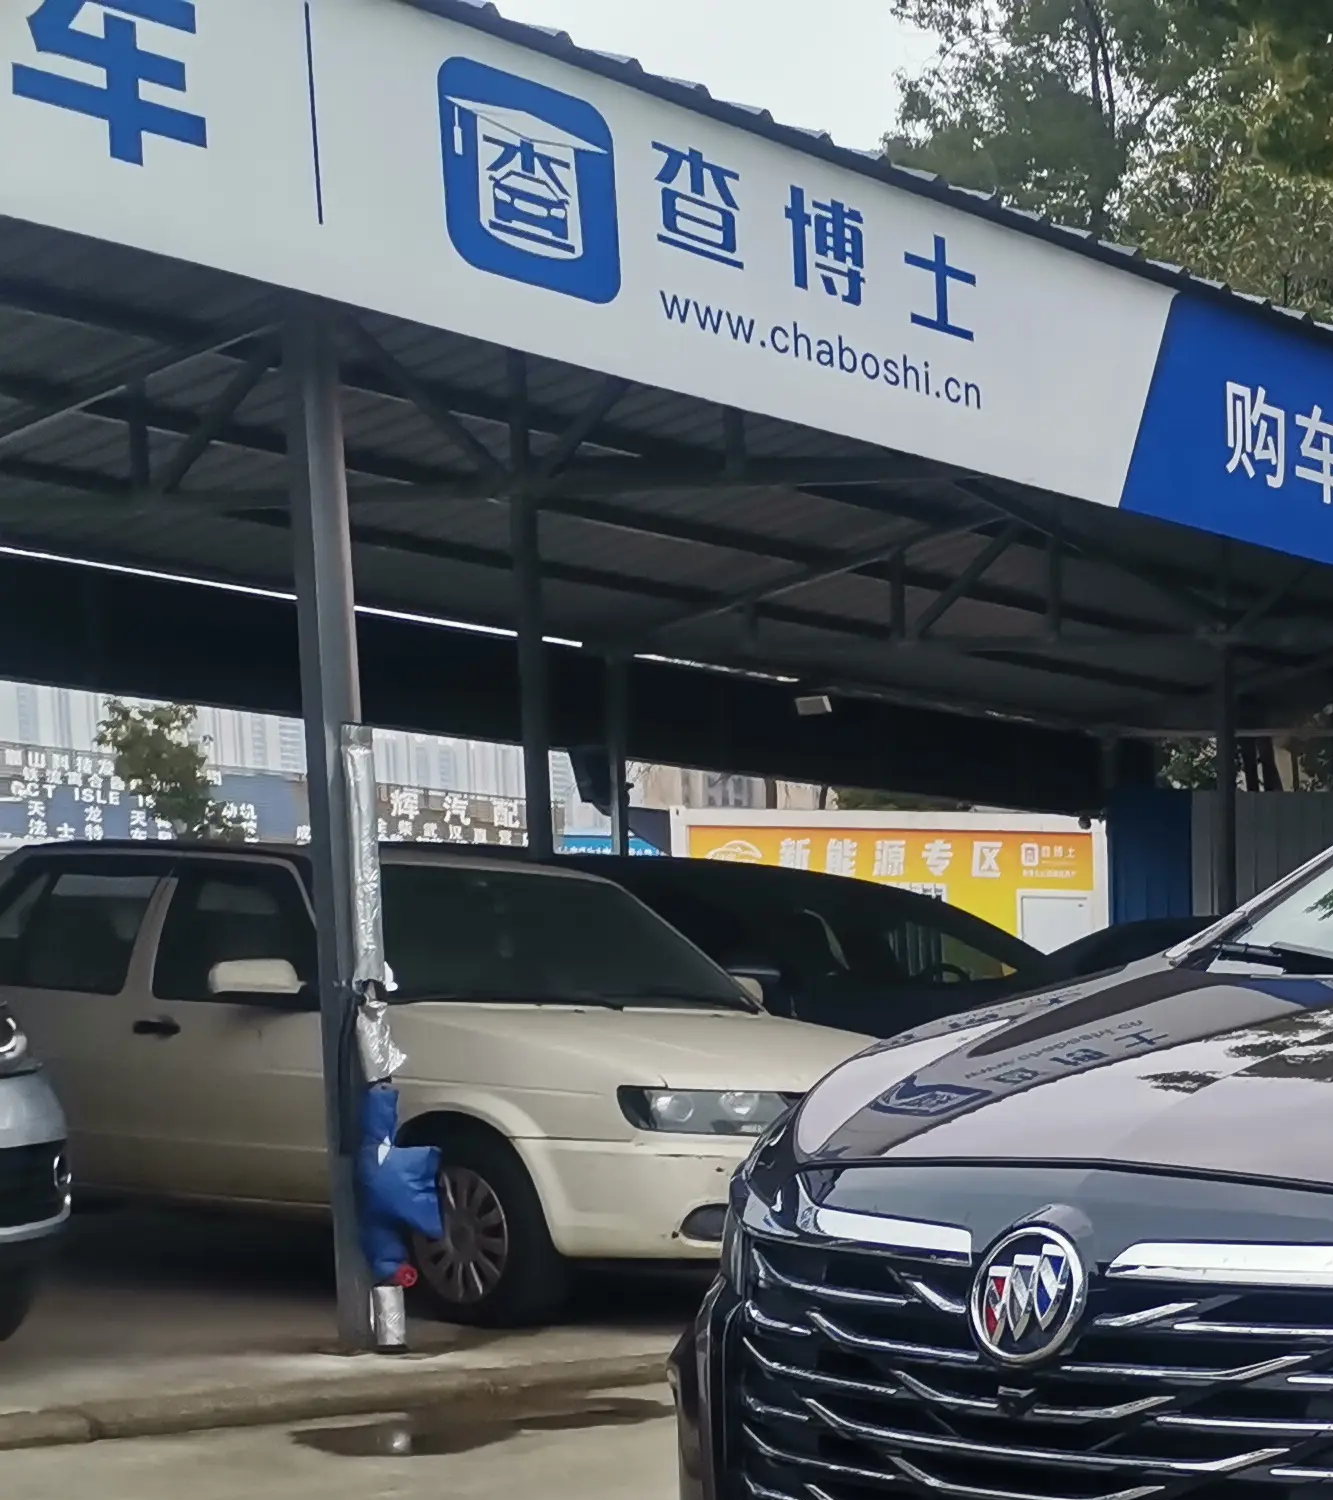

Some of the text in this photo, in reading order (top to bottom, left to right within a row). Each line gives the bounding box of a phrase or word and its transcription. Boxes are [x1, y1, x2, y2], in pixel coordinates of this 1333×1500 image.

[12, 0, 207, 166] 车
[651, 140, 977, 341] 查博士
[659, 289, 982, 410] www.chaboshi.cn
[779, 837, 1002, 878] 新能源专区
